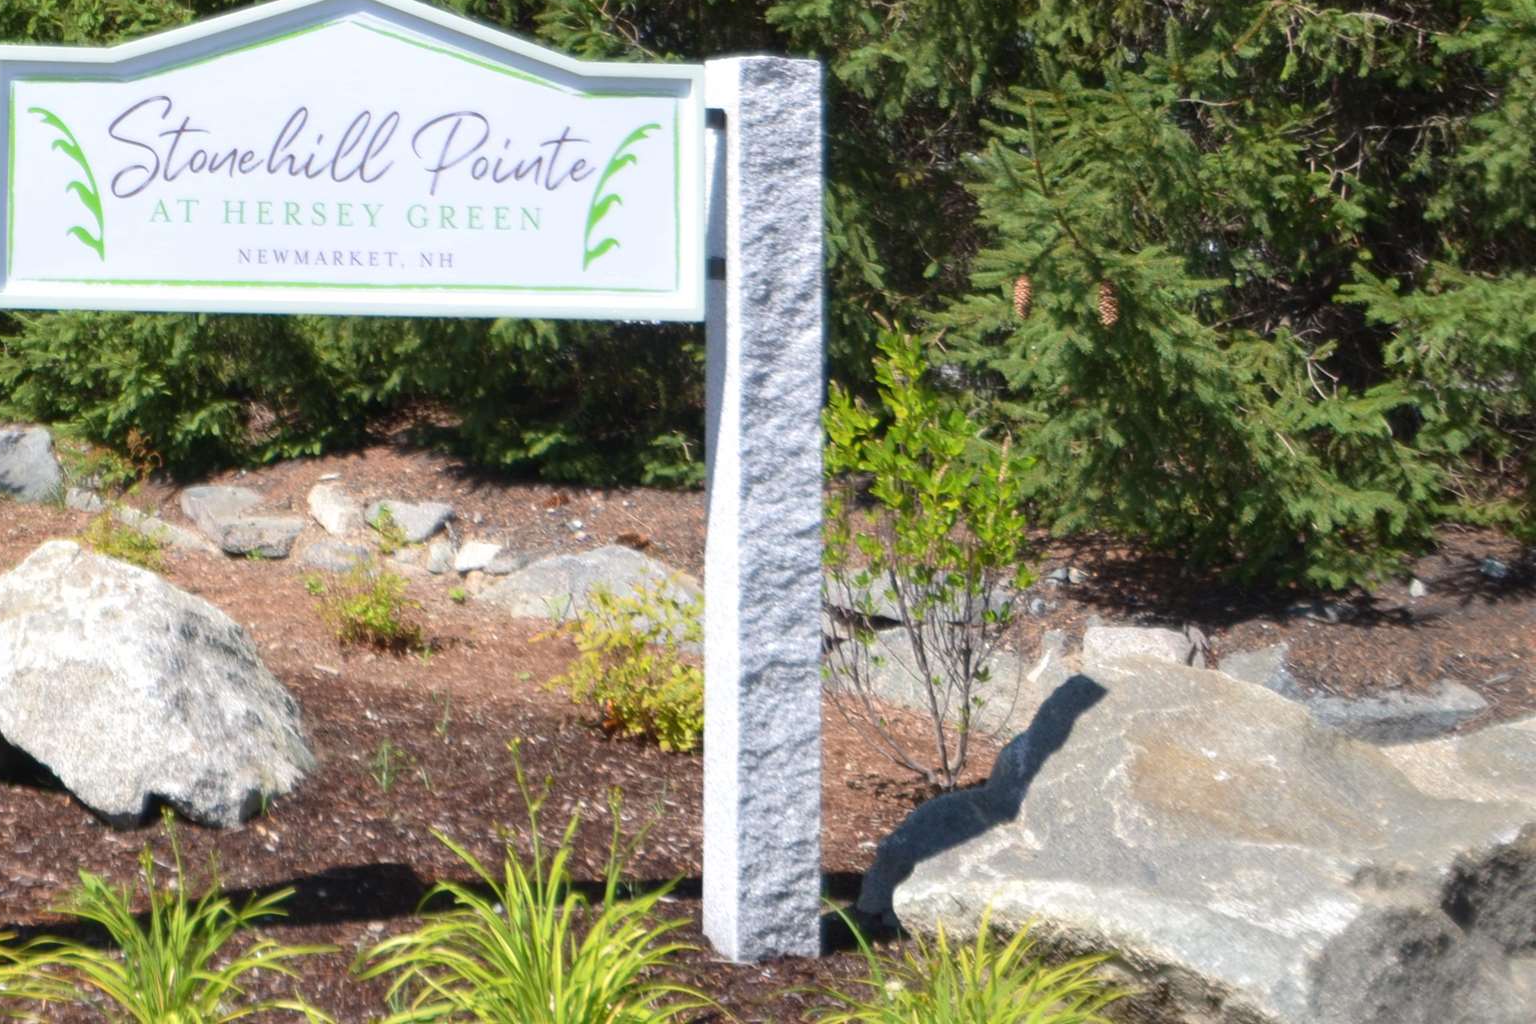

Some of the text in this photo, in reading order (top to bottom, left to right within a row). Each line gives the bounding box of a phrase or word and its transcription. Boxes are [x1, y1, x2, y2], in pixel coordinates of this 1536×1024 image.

[107, 95, 596, 198] Stonehill Pointe
[149, 199, 543, 230] AT HERSEY GREEN
[419, 252, 455, 269] NH
